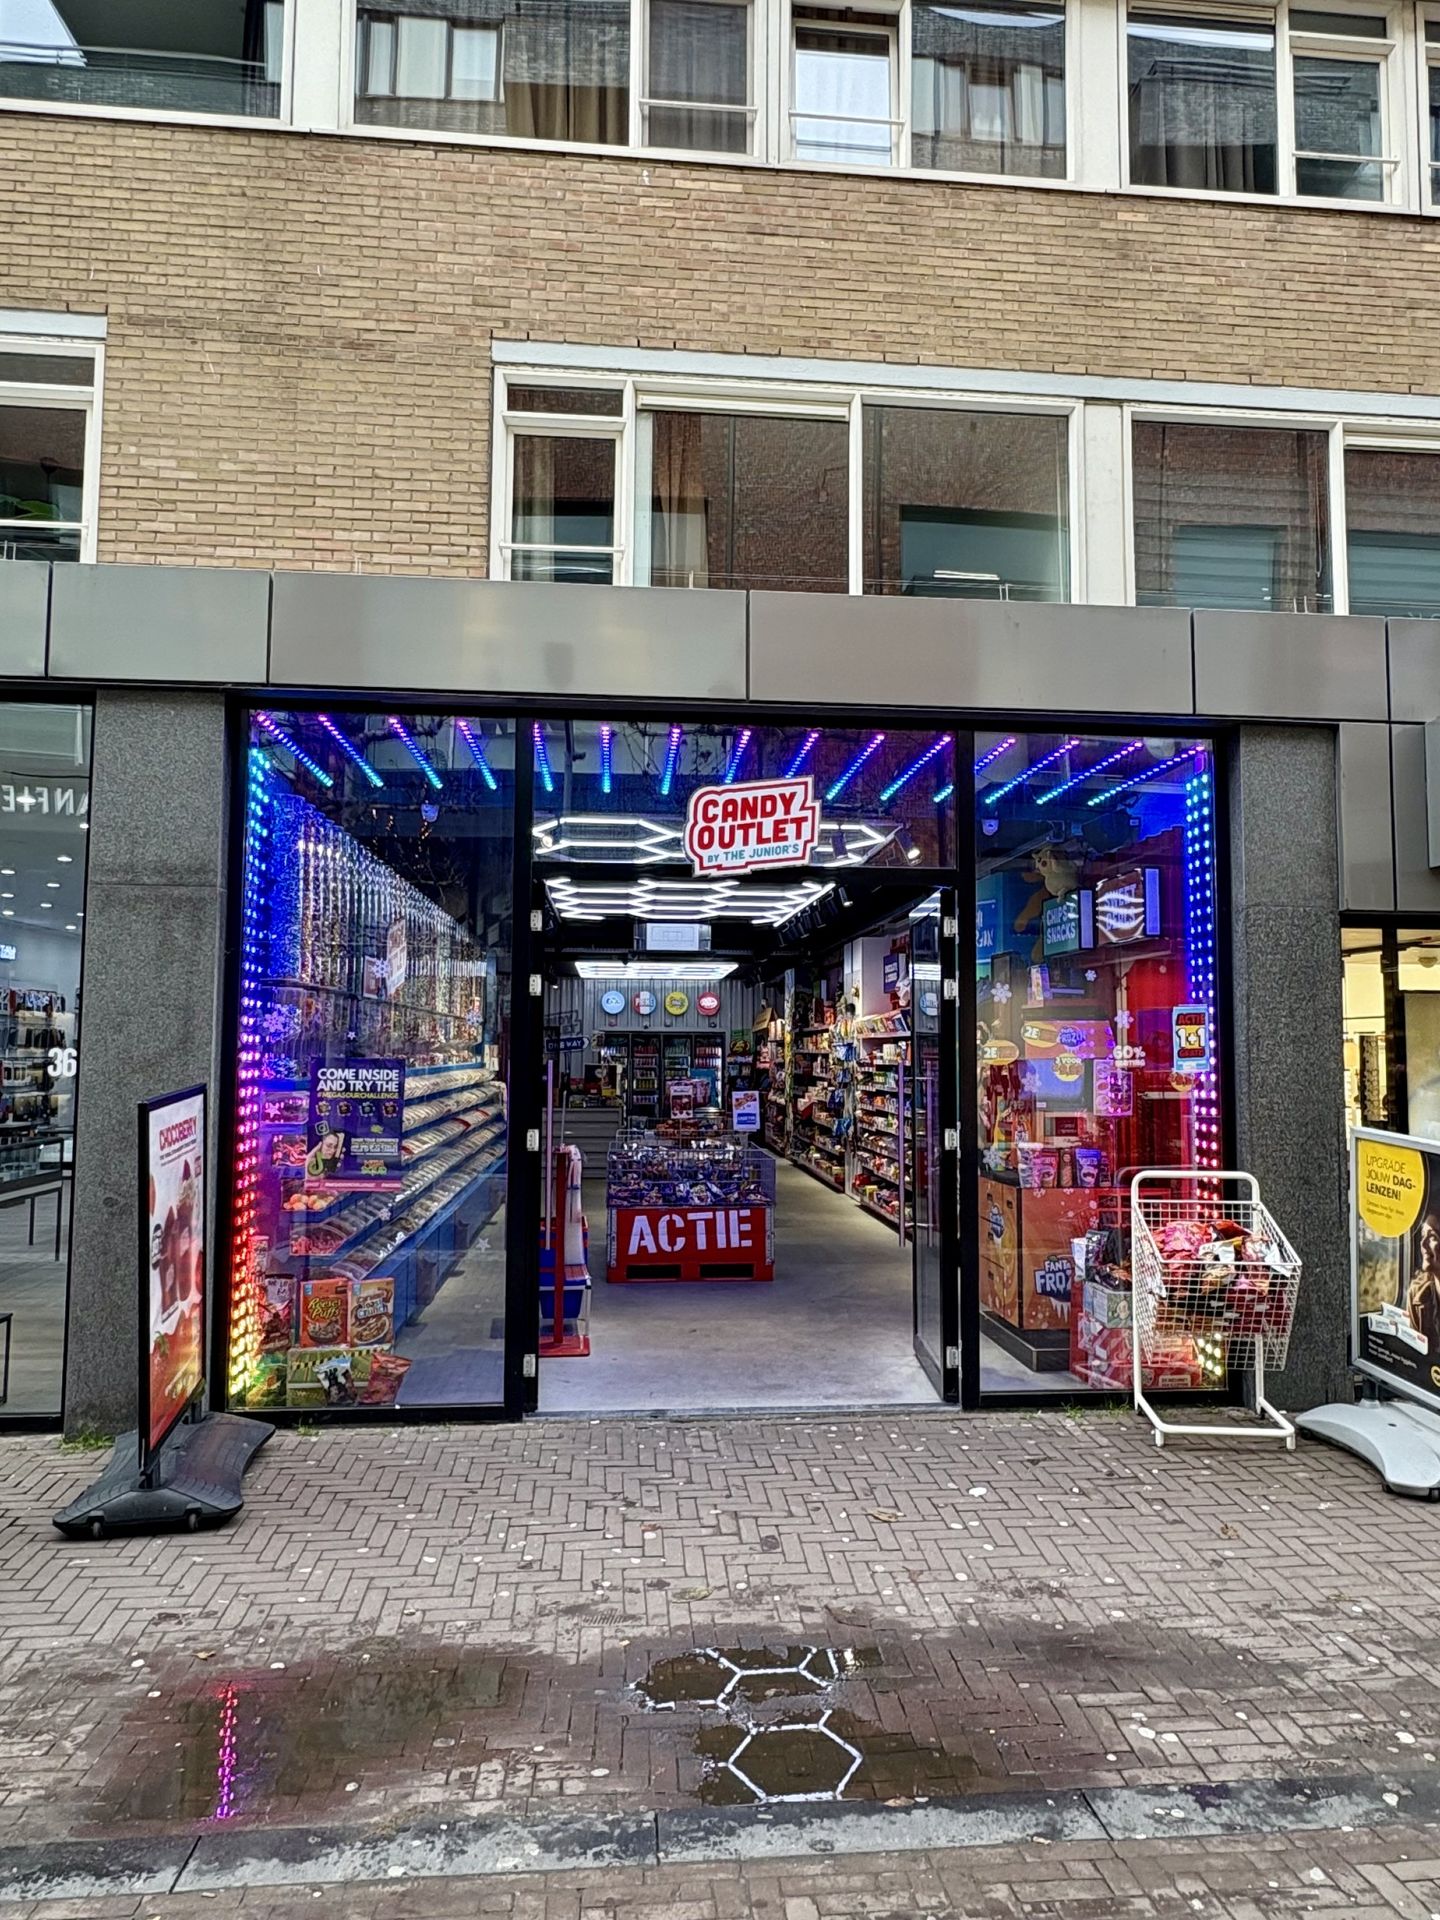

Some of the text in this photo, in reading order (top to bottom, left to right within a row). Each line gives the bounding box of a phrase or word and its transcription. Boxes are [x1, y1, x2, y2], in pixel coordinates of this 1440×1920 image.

[702, 791, 797, 824] CANDY
[697, 816, 808, 850] OUTLET
[707, 843, 800, 863] BY THE JUNIOR'S
[1046, 904, 1068, 927] CHIPS
[1046, 921, 1076, 945] SNACKS
[1177, 1013, 1205, 1025] ACTIE
[1024, 1025, 1040, 1039] 2E
[1177, 1027, 1205, 1048] 1+1
[566, 1038, 582, 1048] WAY
[983, 1047, 998, 1059] 2E
[1112, 1044, 1146, 1060] 60%
[47, 1047, 77, 1077] 36
[317, 1068, 400, 1080] COME INSIDE
[316, 1080, 399, 1092] AND TRY THE
[1366, 1154, 1407, 1174] UPGRADE
[1366, 1169, 1416, 1190] JOUW DAG-
[1366, 1181, 1401, 1201] LENZEN!
[628, 1209, 752, 1255] ACTIE
